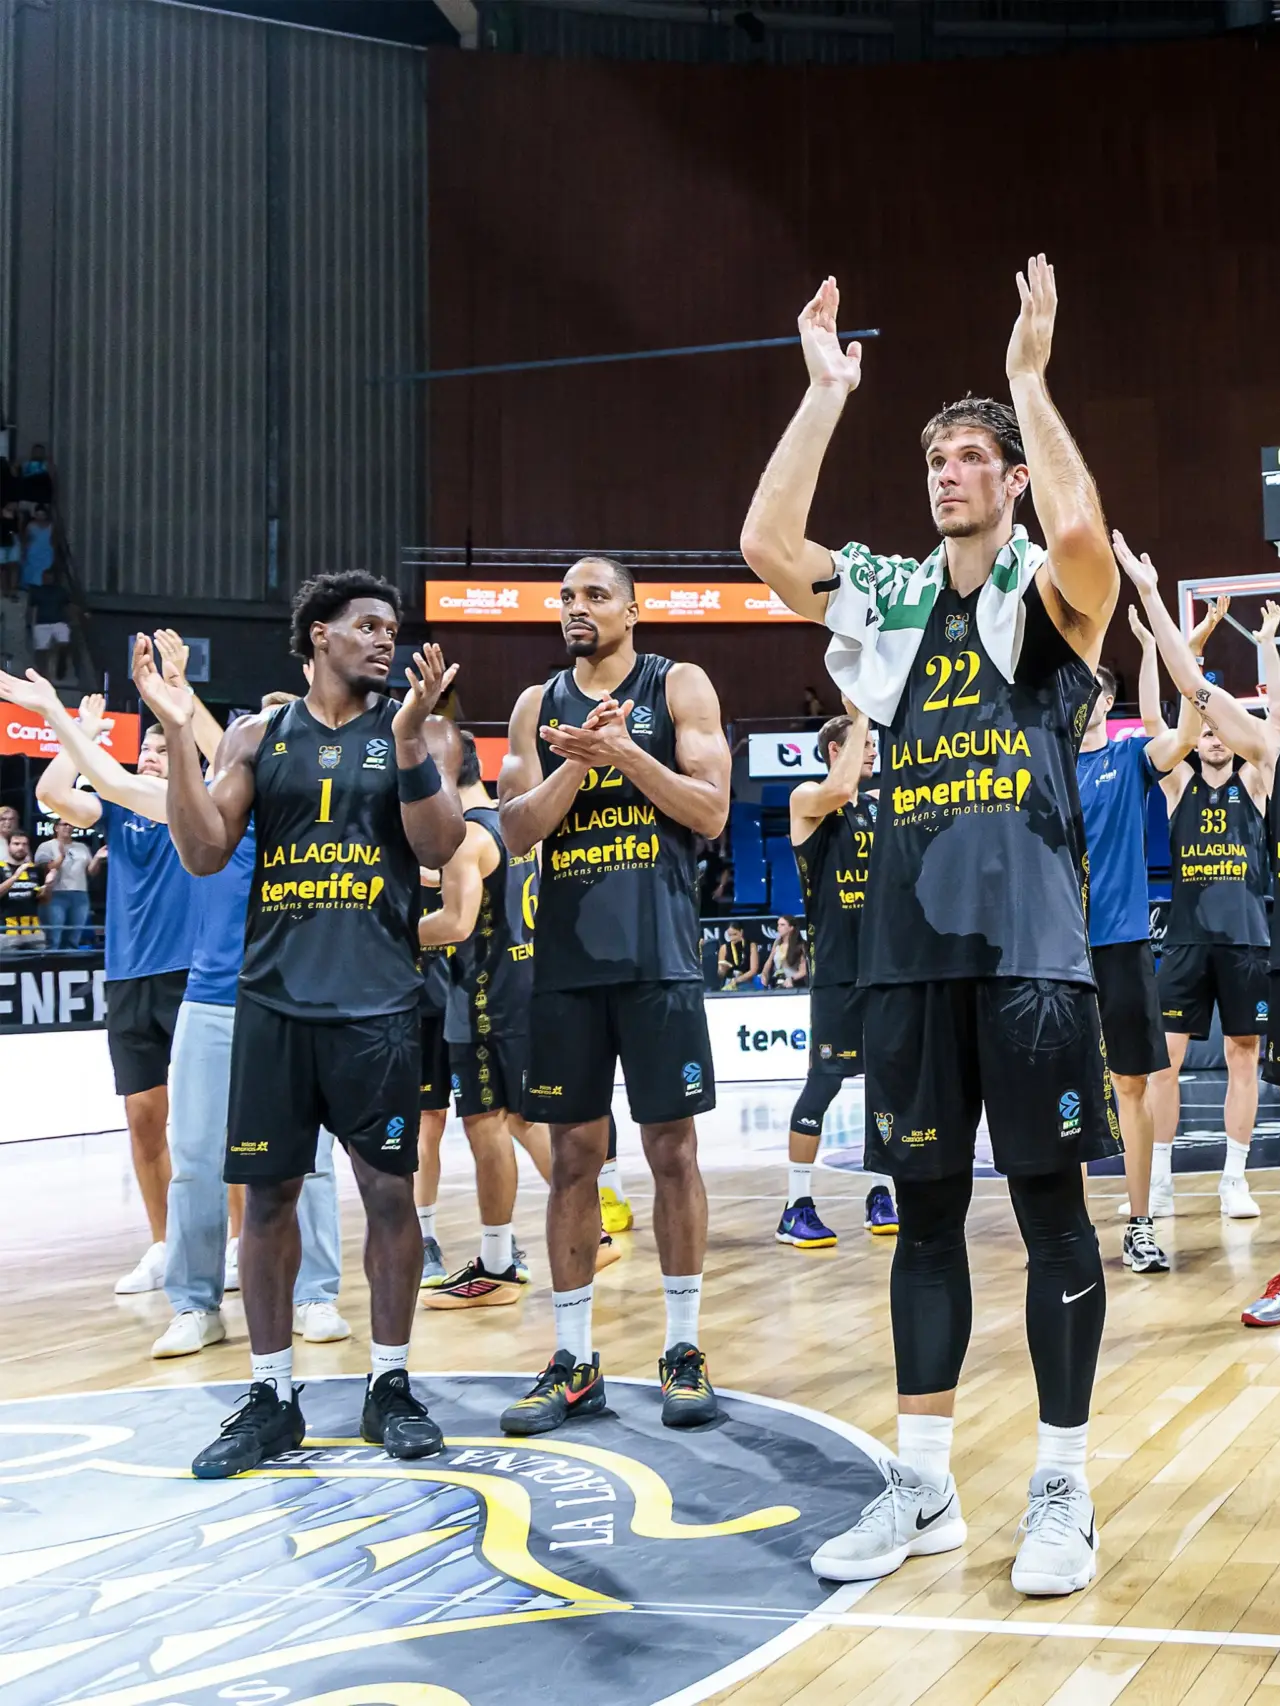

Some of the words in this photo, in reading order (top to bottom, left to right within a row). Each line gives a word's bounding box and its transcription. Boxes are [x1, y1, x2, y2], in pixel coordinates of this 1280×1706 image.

[923, 650, 981, 712] 22
[7, 722, 59, 741] Cana
[892, 742, 913, 770] LA
[917, 729, 1032, 764] LAGUNA
[314, 778, 333, 823] 1
[892, 768, 1032, 815] tenerife!
[557, 822, 571, 836] A
[574, 805, 657, 832] LAGUNA
[943, 803, 1011, 817] emotions
[1200, 808, 1227, 834] 33
[264, 846, 285, 868] LA
[290, 843, 381, 867] LAGUNA
[551, 834, 660, 870] tenerife!
[1181, 844, 1196, 858] LA
[1197, 843, 1247, 857] LAGUNA
[596, 861, 649, 874] emotions
[836, 870, 854, 884] LA
[1181, 860, 1248, 881] tenerife!
[261, 873, 385, 909] tenerife!
[308, 900, 364, 910] emotions
[1060, 1127, 1081, 1138] EuroCup
[449, 1449, 617, 1508] LAGUNA
[549, 1513, 616, 1551] LA
